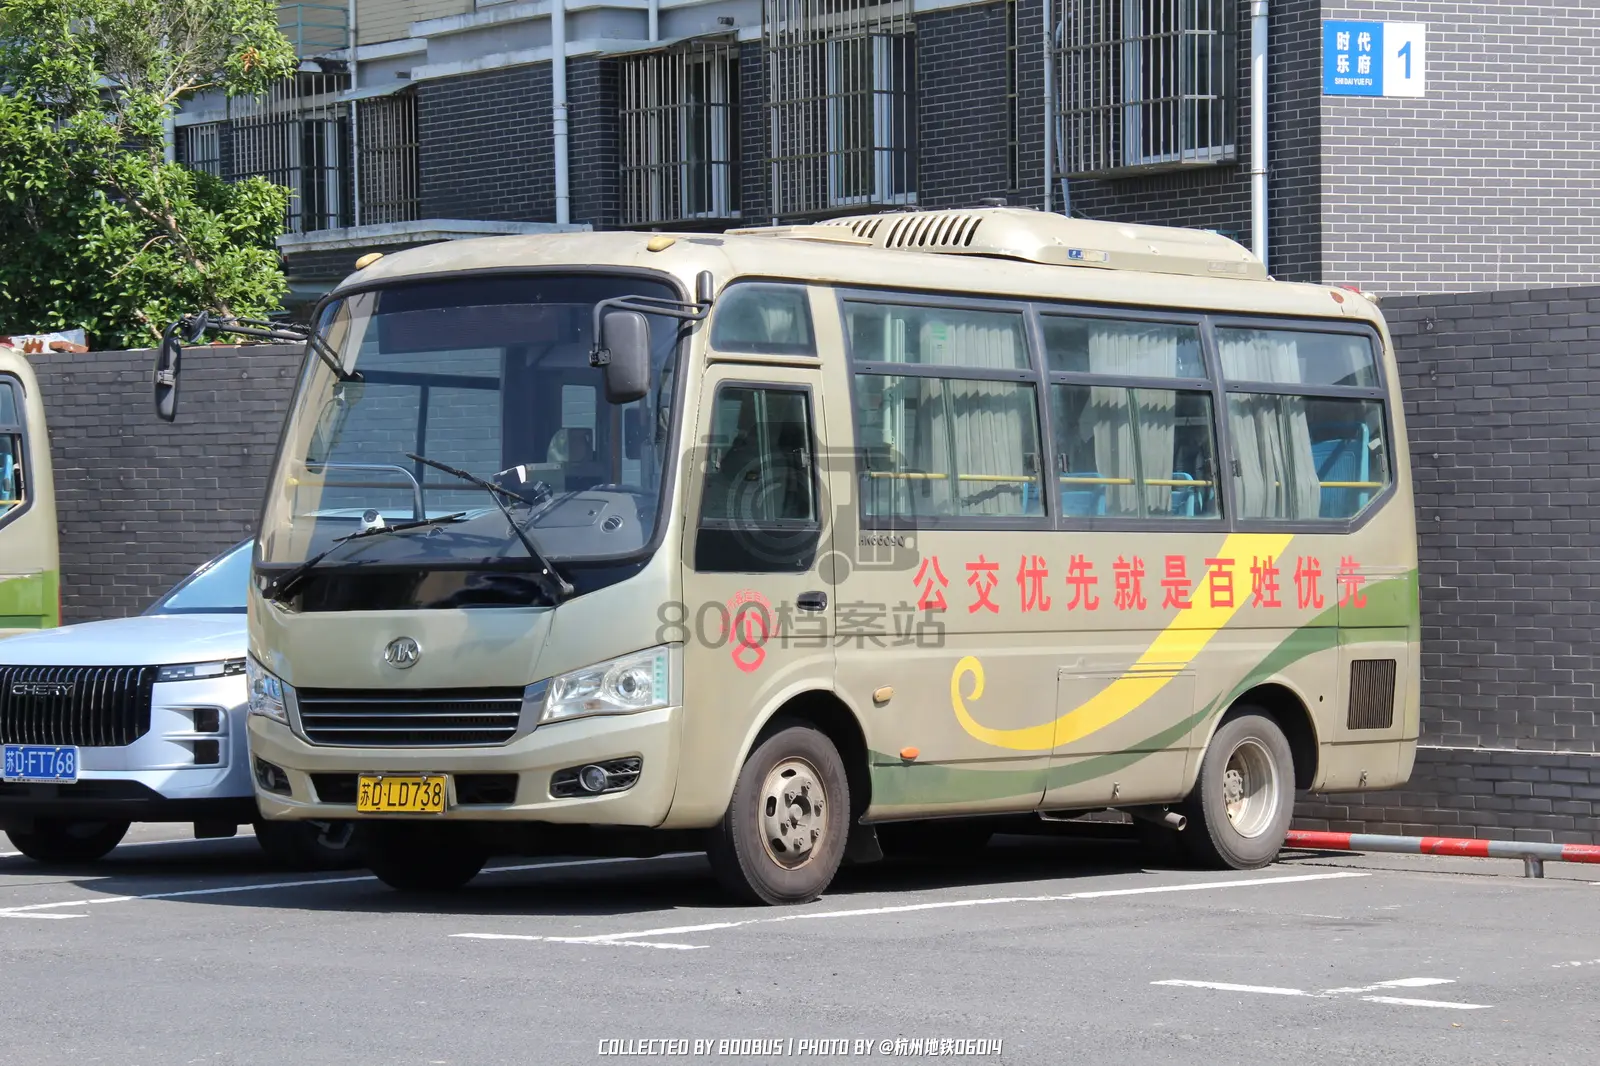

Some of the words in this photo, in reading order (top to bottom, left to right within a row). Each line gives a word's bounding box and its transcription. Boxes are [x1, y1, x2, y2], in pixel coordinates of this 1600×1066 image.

[1336, 31, 1371, 52] 时代
[1397, 40, 1412, 79] 1
[912, 553, 1367, 614] 公交优先就是百姓优先
[12, 684, 74, 695] CHERY
